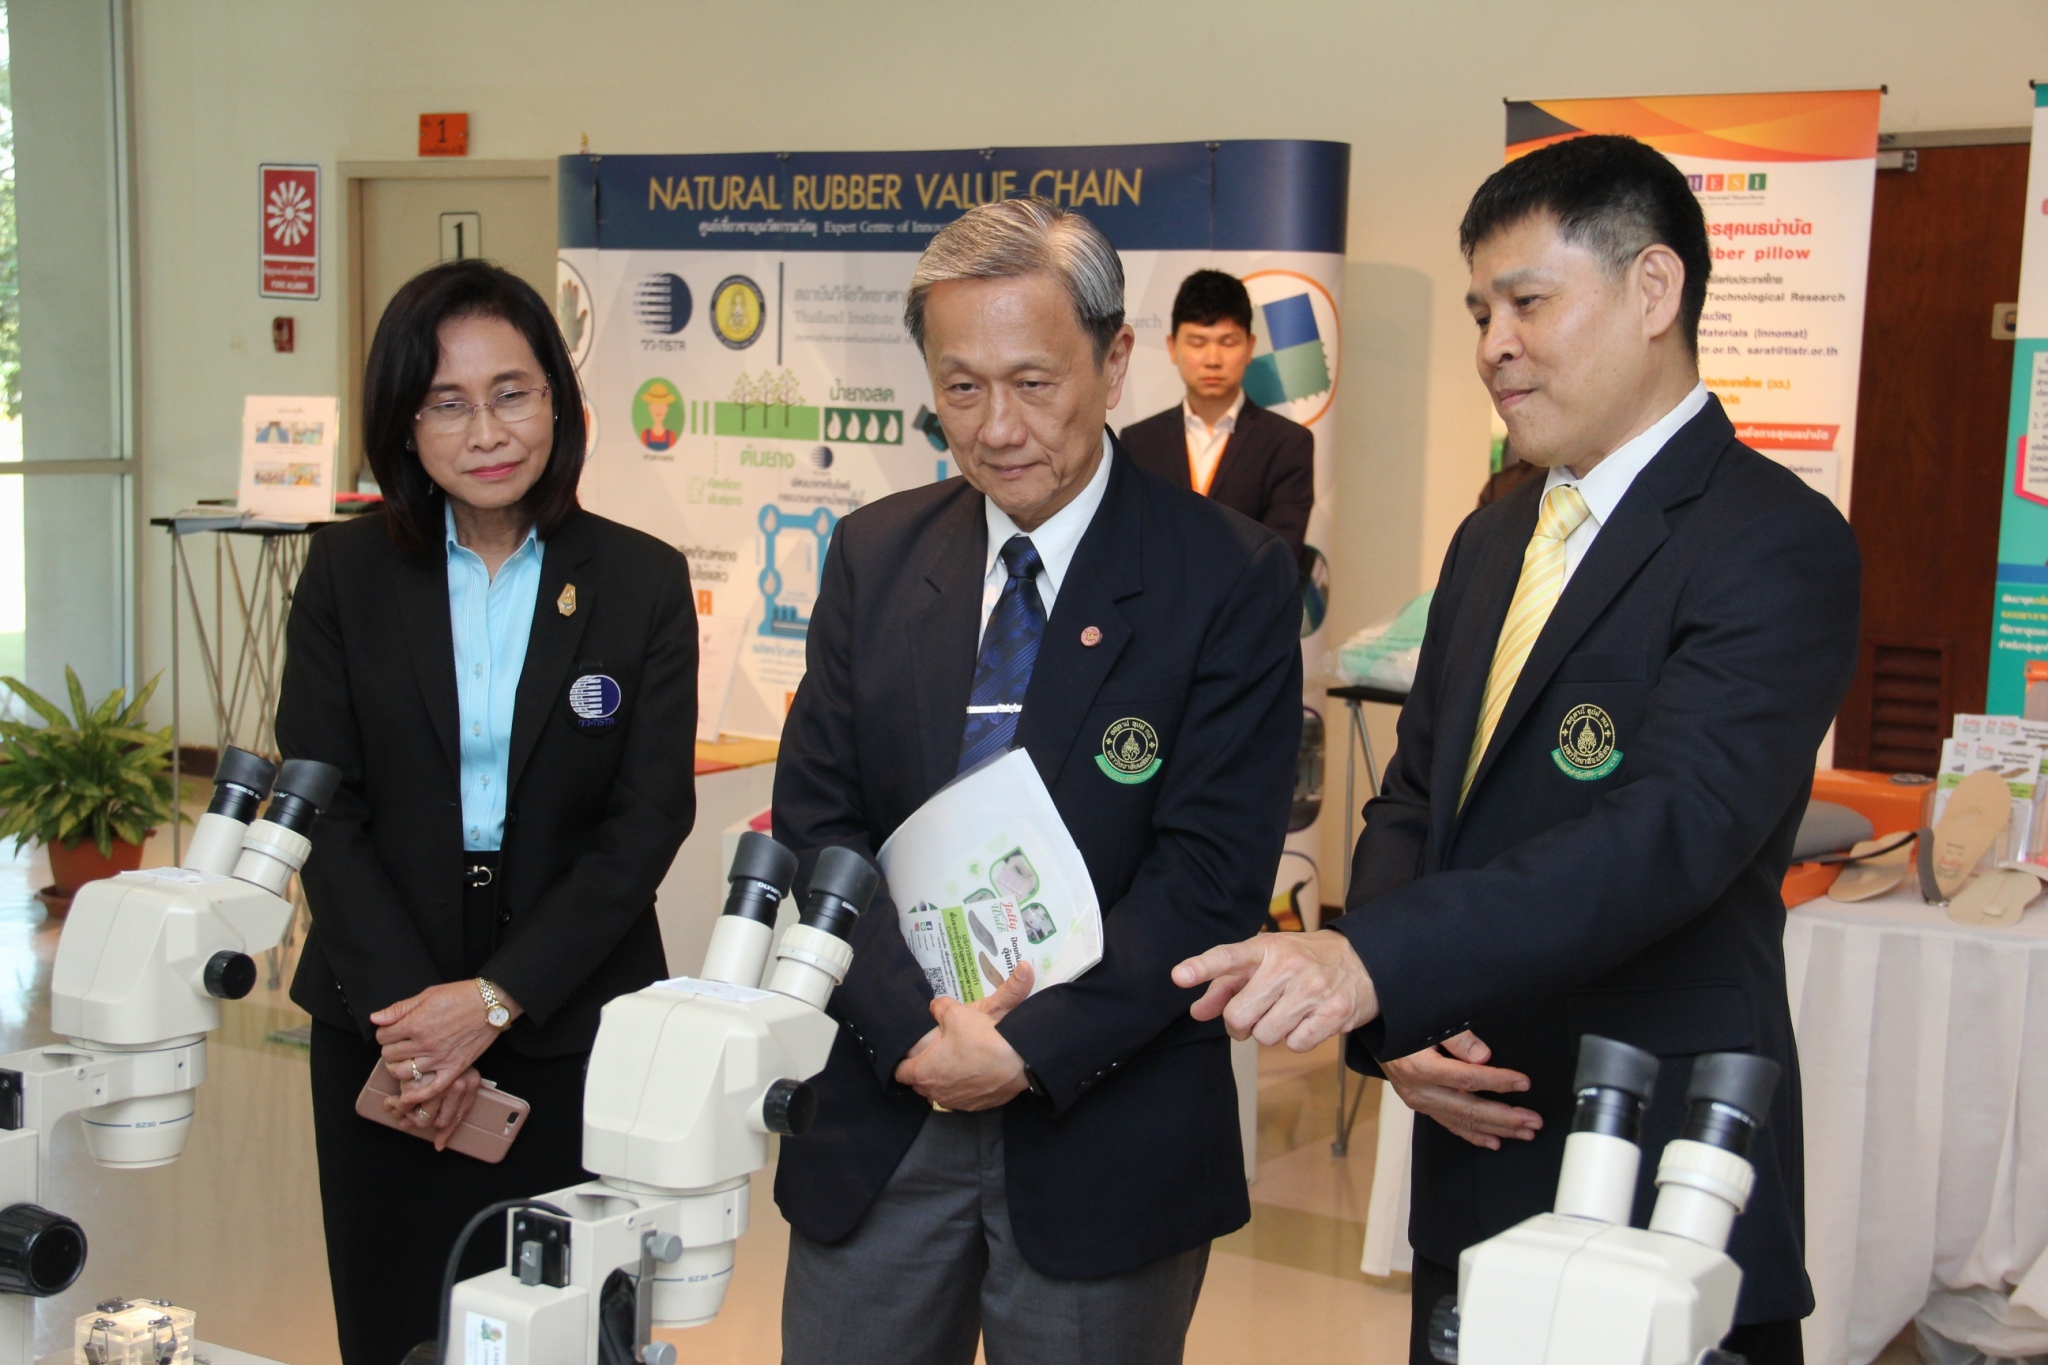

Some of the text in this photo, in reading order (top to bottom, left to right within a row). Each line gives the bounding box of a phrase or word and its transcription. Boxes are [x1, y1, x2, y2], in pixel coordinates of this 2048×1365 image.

[438, 118, 448, 144] 1
[649, 168, 1143, 211] NATURAL RUBBER VALUE CHAIN
[824, 221, 857, 236] Expert
[860, 221, 894, 233] Centre
[897, 220, 909, 233] of
[1755, 246, 1810, 263] pillow
[1708, 292, 1845, 303] Technological Research
[1698, 328, 1808, 340] Materials (Innomat)
[1747, 346, 1838, 356] sarat@tistr.or.th
[990, 903, 1006, 933] Walk
[1002, 901, 1019, 931] Jolly
[945, 925, 956, 951] Custom
[952, 952, 963, 978] Orthotic
[1000, 947, 1017, 976] อุ้งเท้า
